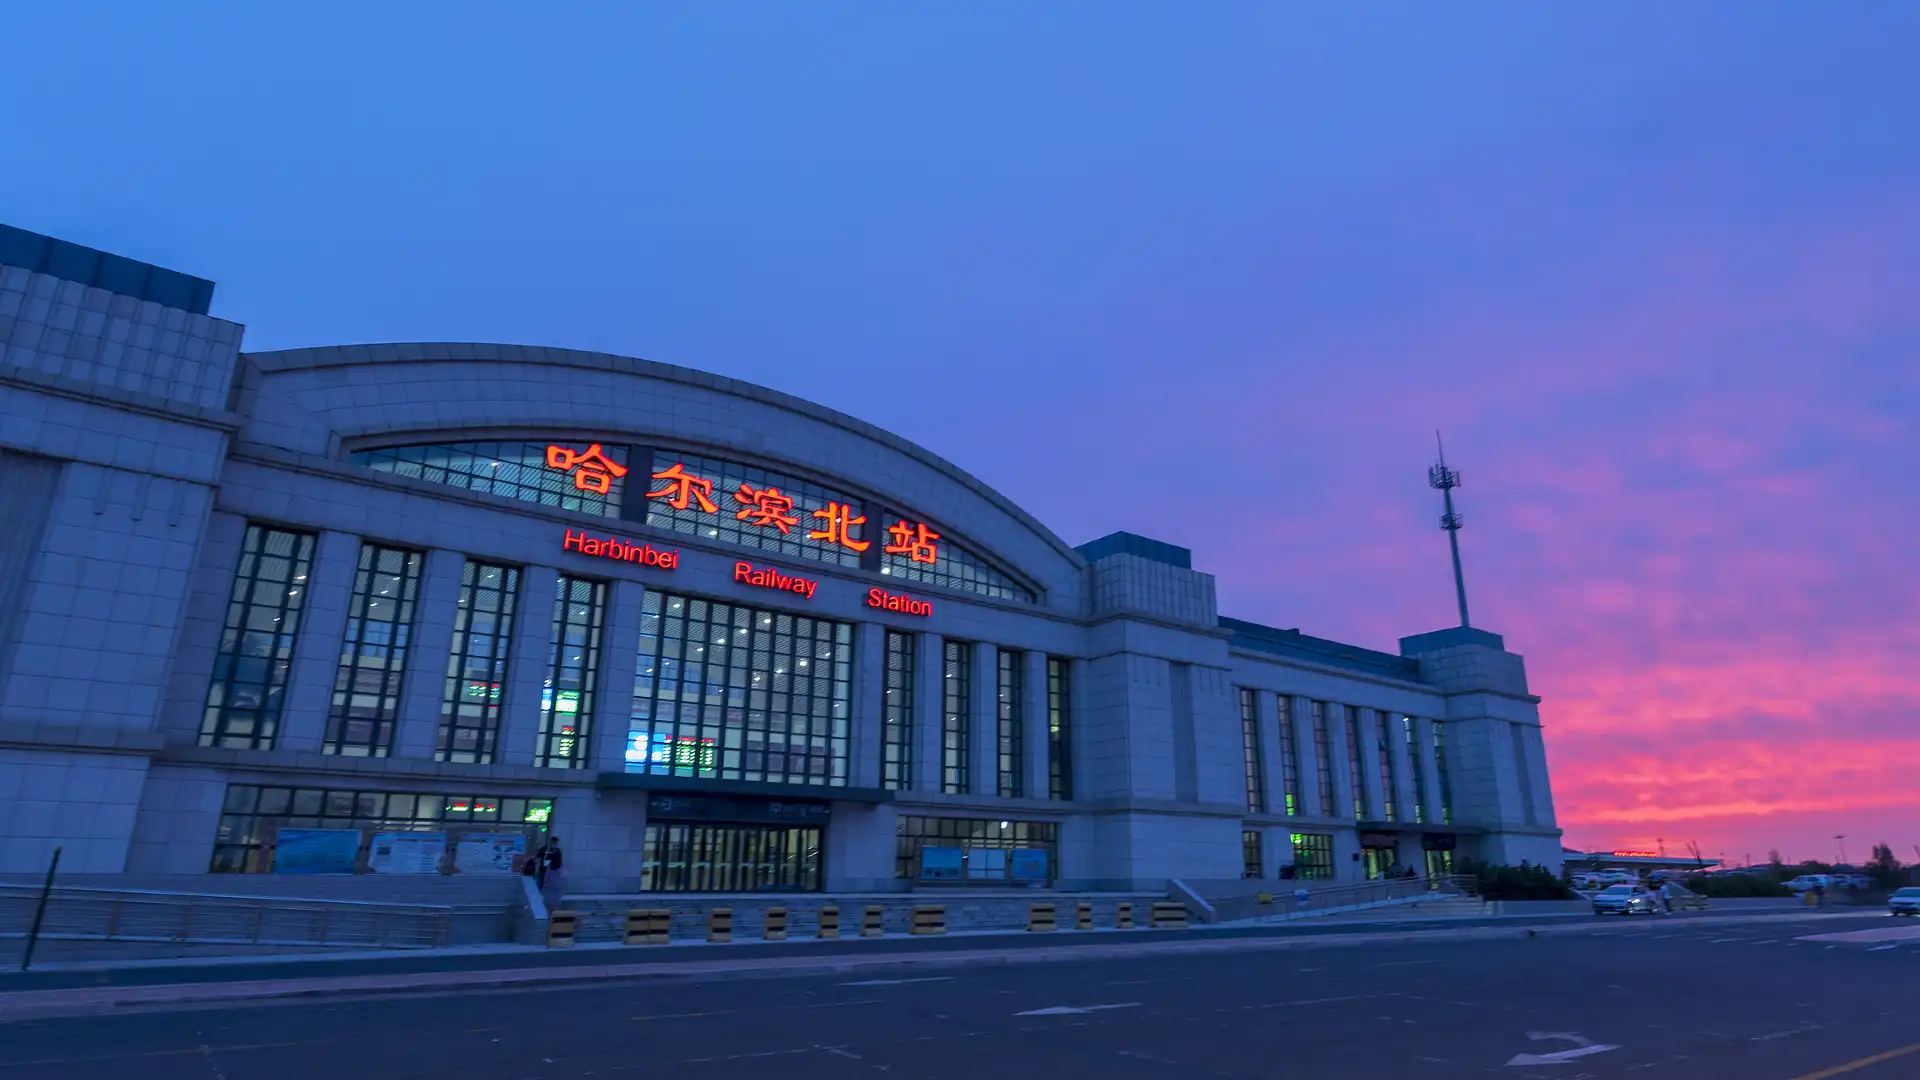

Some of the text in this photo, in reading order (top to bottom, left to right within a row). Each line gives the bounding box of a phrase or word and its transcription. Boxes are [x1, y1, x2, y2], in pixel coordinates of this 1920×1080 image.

[546, 443, 941, 565] 哈尔滨北站
[563, 528, 933, 617] Harbinbei Railway Station
